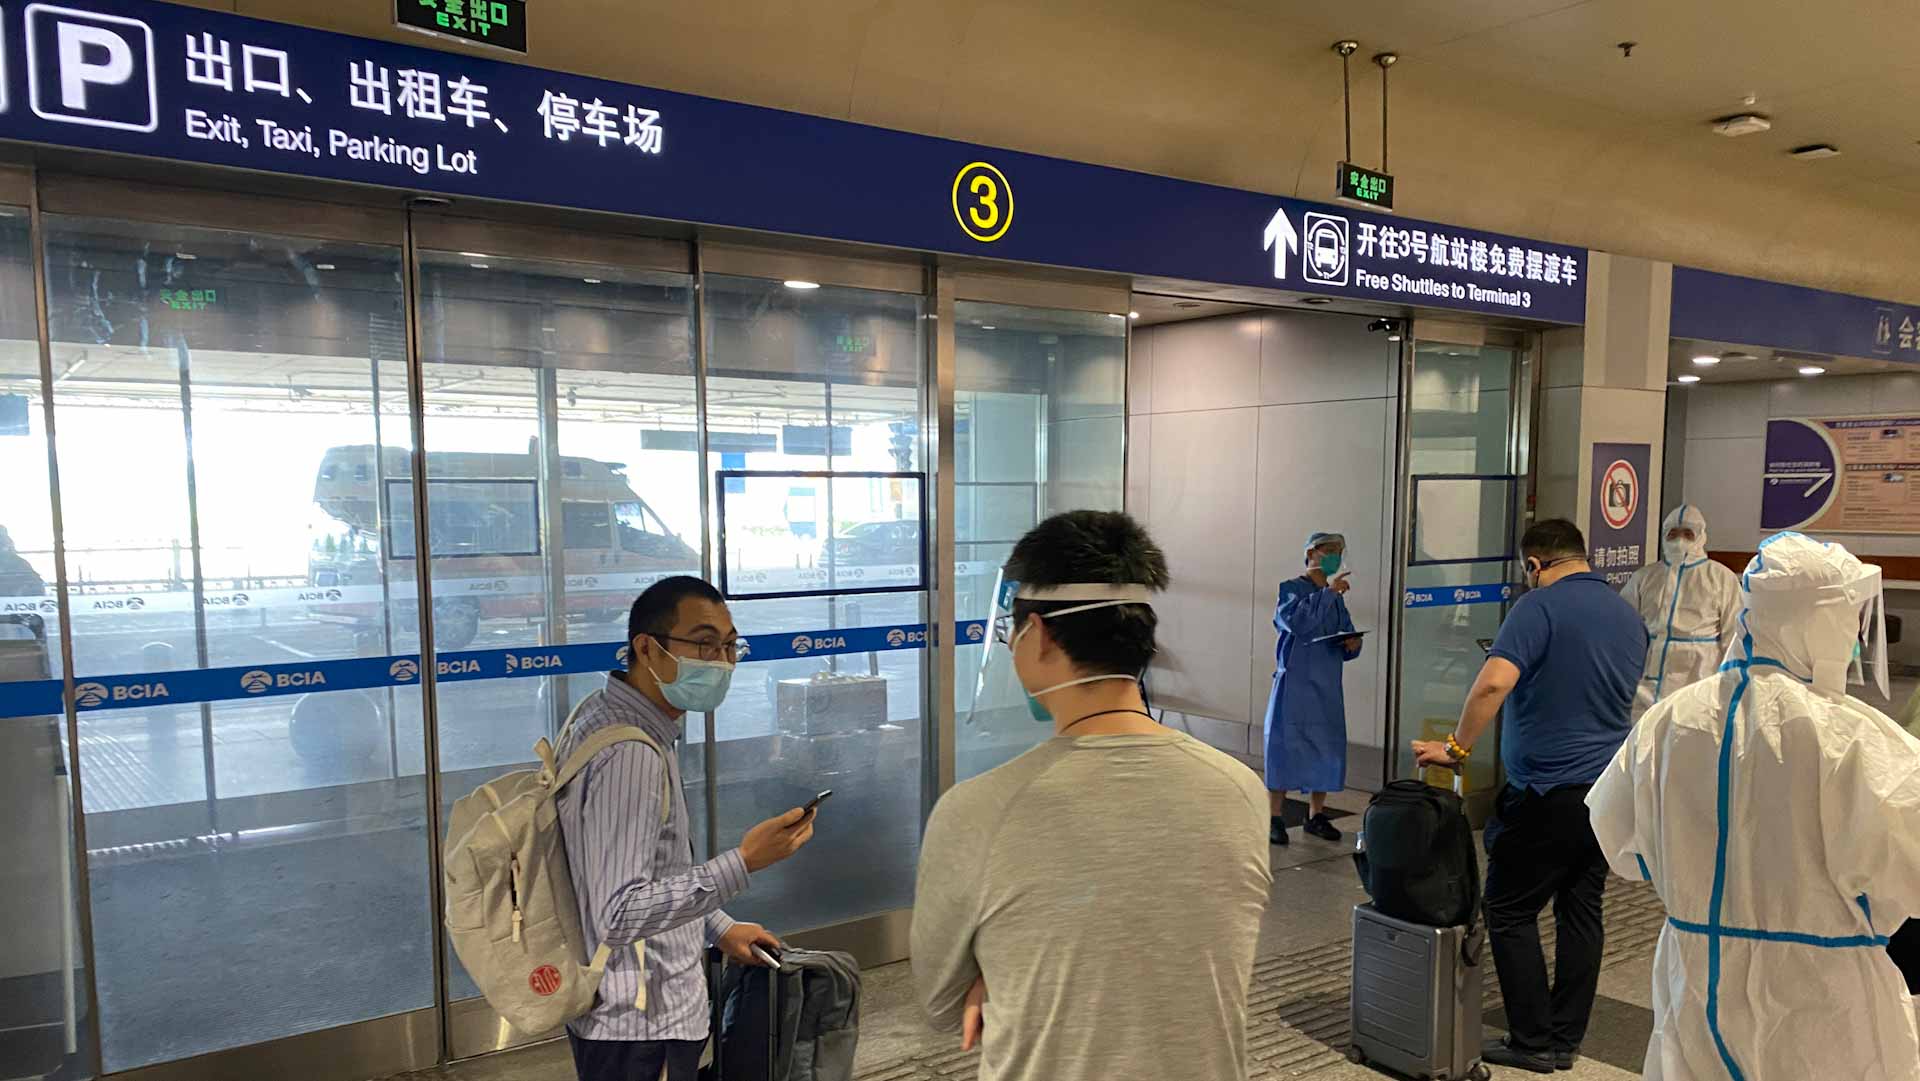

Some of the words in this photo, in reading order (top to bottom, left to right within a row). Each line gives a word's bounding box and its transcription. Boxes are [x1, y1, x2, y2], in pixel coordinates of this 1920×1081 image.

[436, 11, 491, 36] EXIT
[57, 21, 133, 110] P
[185, 108, 249, 149] Exit,
[256, 118, 321, 159] Taxi,
[328, 128, 430, 175] Parking
[436, 143, 478, 175] Lot
[1350, 171, 1387, 193] 安全出口
[969, 175, 999, 229] 3
[1356, 187, 1379, 201] EXIT
[1356, 222, 1578, 286] 开往3号航站楼免费摆渡车
[1355, 268, 1389, 290] Free
[1391, 273, 1450, 298] Shuttles
[1451, 281, 1466, 300] to
[1466, 283, 1521, 307] Terminal
[1522, 292, 1532, 308] 3
[1594, 545, 1640, 568] 请勿拍照
[814, 637, 846, 650] BCIA
[907, 631, 928, 643] BCI
[437, 660, 481, 674] BCIA
[520, 654, 563, 670] BCIA
[276, 671, 326, 688] BCIA
[113, 683, 169, 700] BCIA
